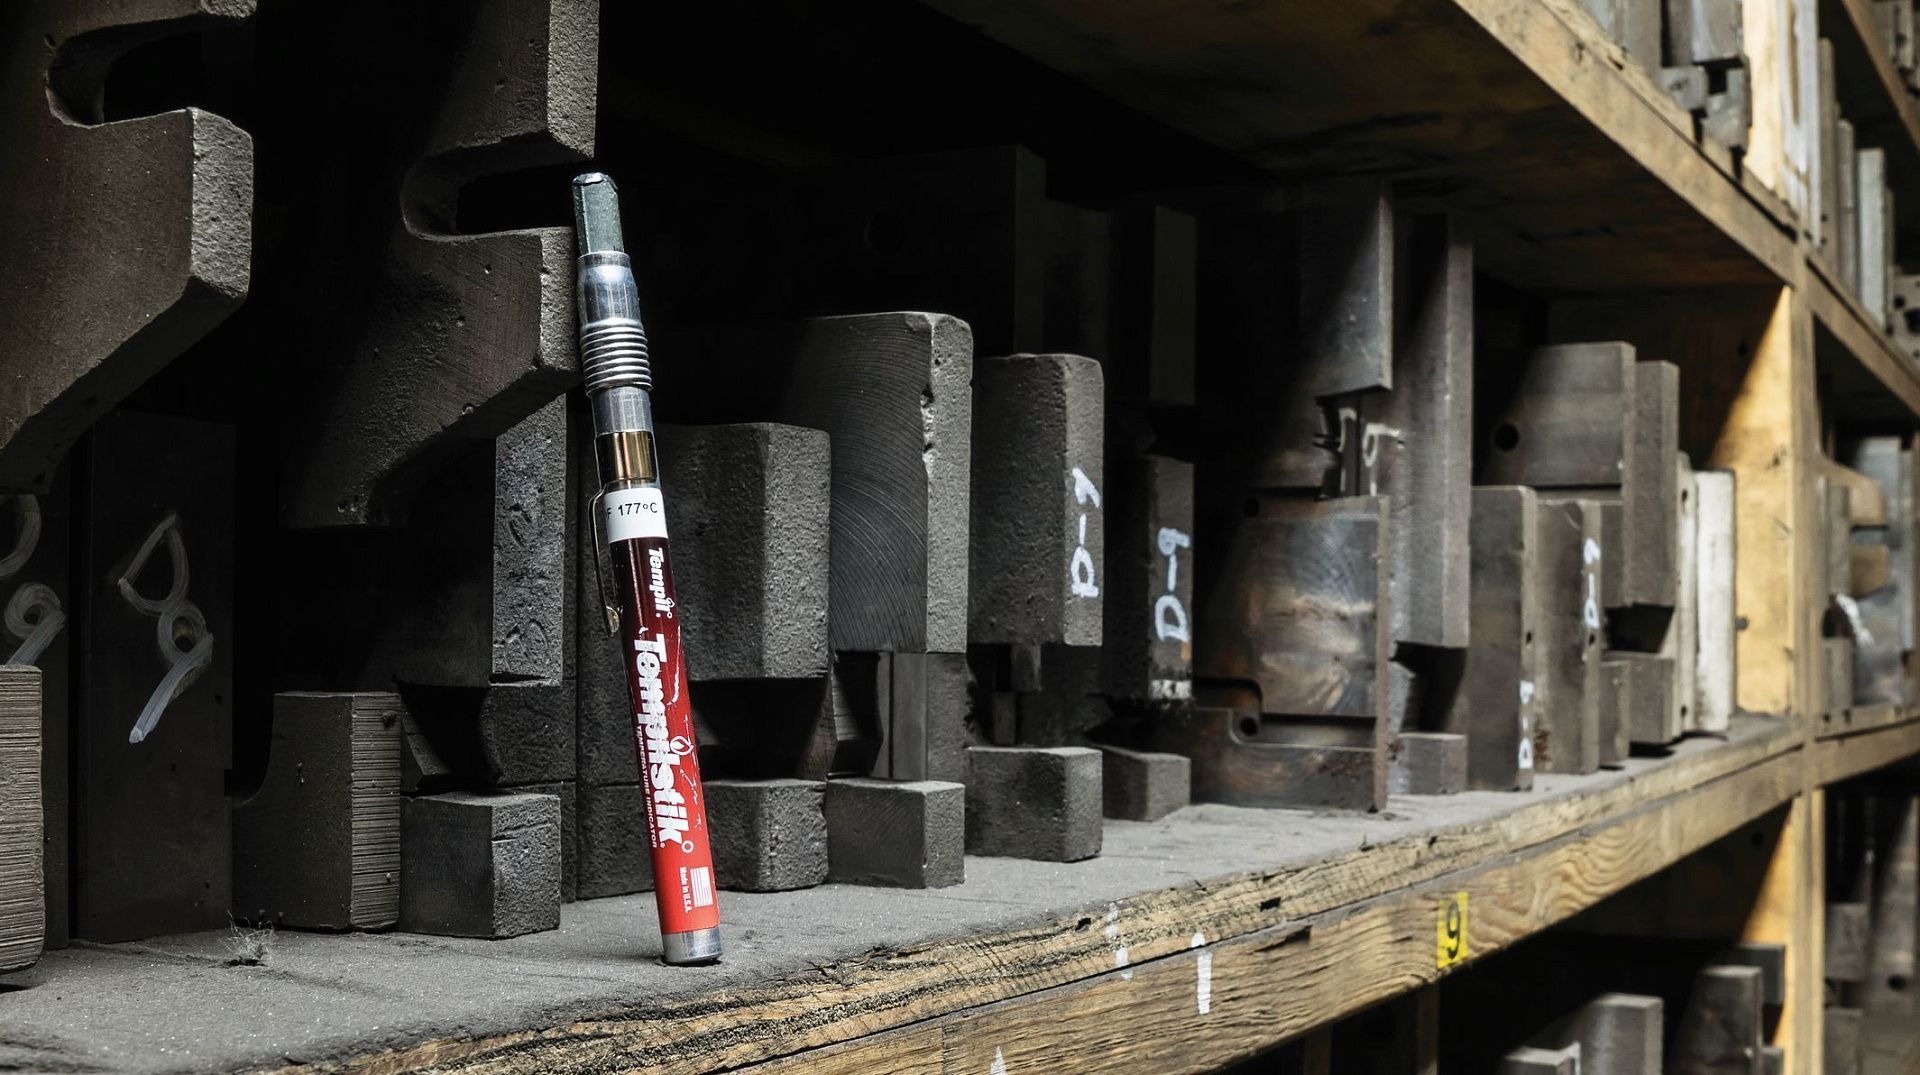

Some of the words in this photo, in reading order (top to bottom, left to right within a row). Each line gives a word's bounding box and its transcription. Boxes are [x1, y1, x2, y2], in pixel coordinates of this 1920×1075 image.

[1154, 527, 1191, 645] D-9
[636, 725, 651, 795] TEMPERATURE
[646, 796, 658, 848] INDICATOR
[679, 866, 688, 885] Made
[1446, 902, 1461, 960] 9
